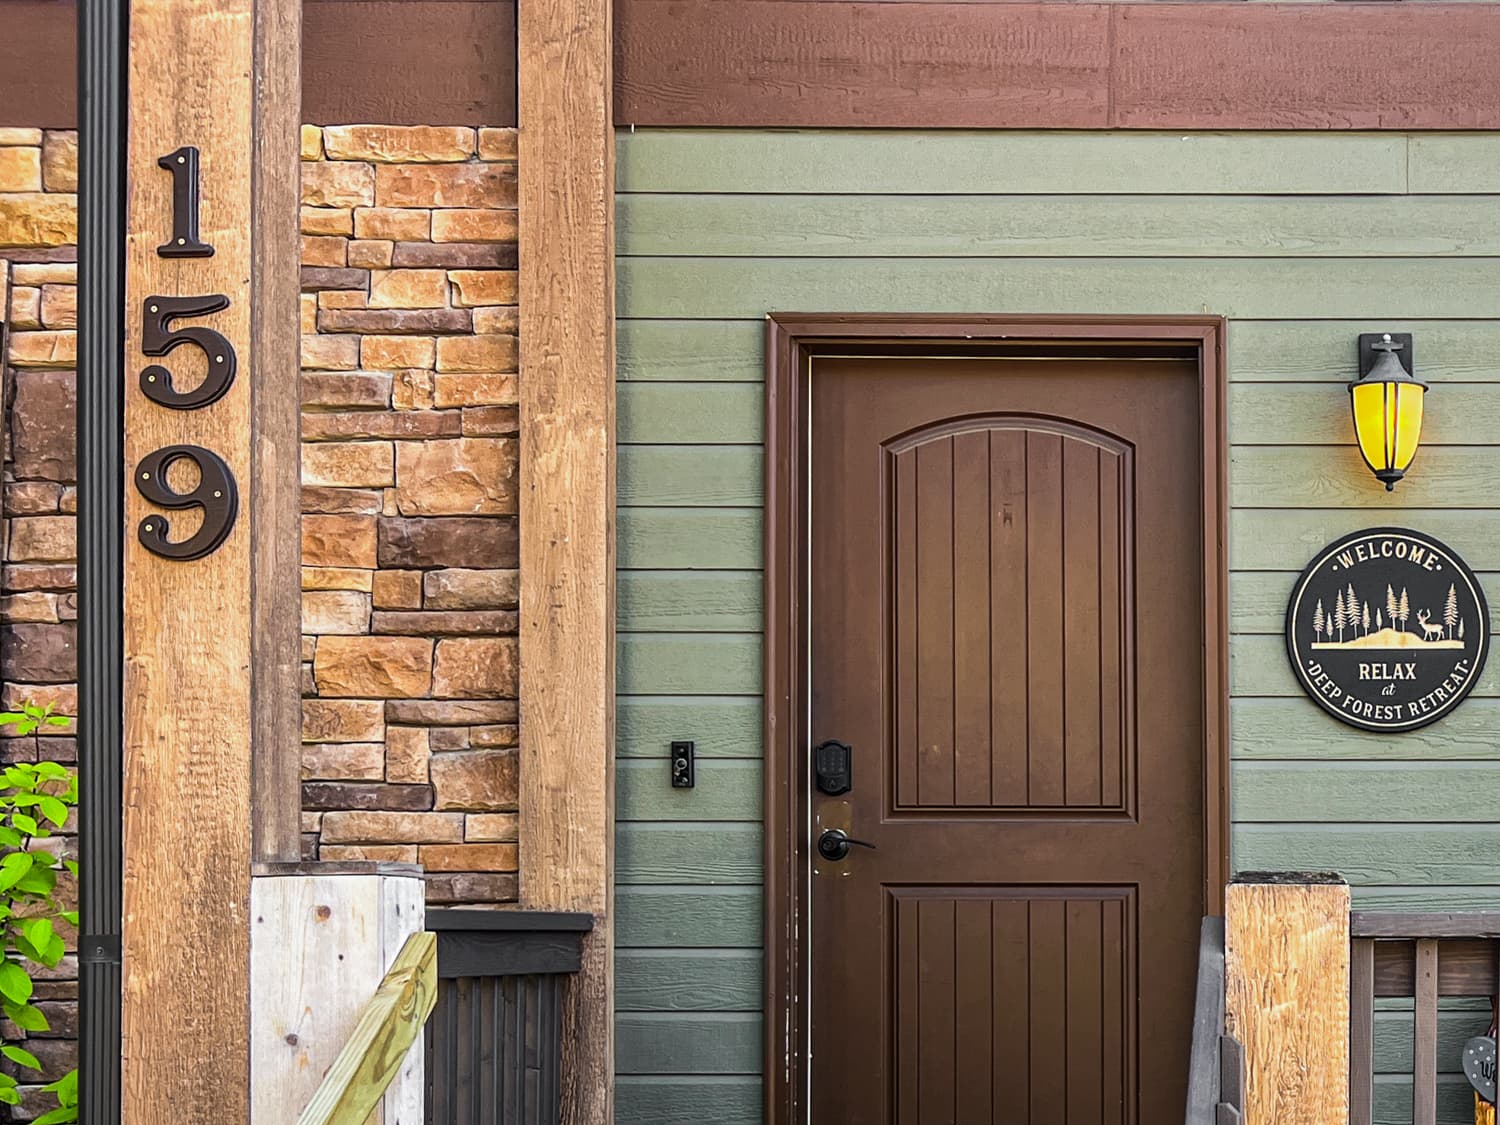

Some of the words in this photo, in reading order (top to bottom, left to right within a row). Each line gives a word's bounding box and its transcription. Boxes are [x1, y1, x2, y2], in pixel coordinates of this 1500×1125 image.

[135, 146, 238, 562] 159
[1336, 540, 1439, 571] WELCOME
[1358, 662, 1417, 680] RELAX
[1308, 663, 1342, 699] DEEP
[1343, 697, 1402, 720] FOREST
[1408, 663, 1469, 717] RETREAT
[1381, 682, 1396, 696] at
